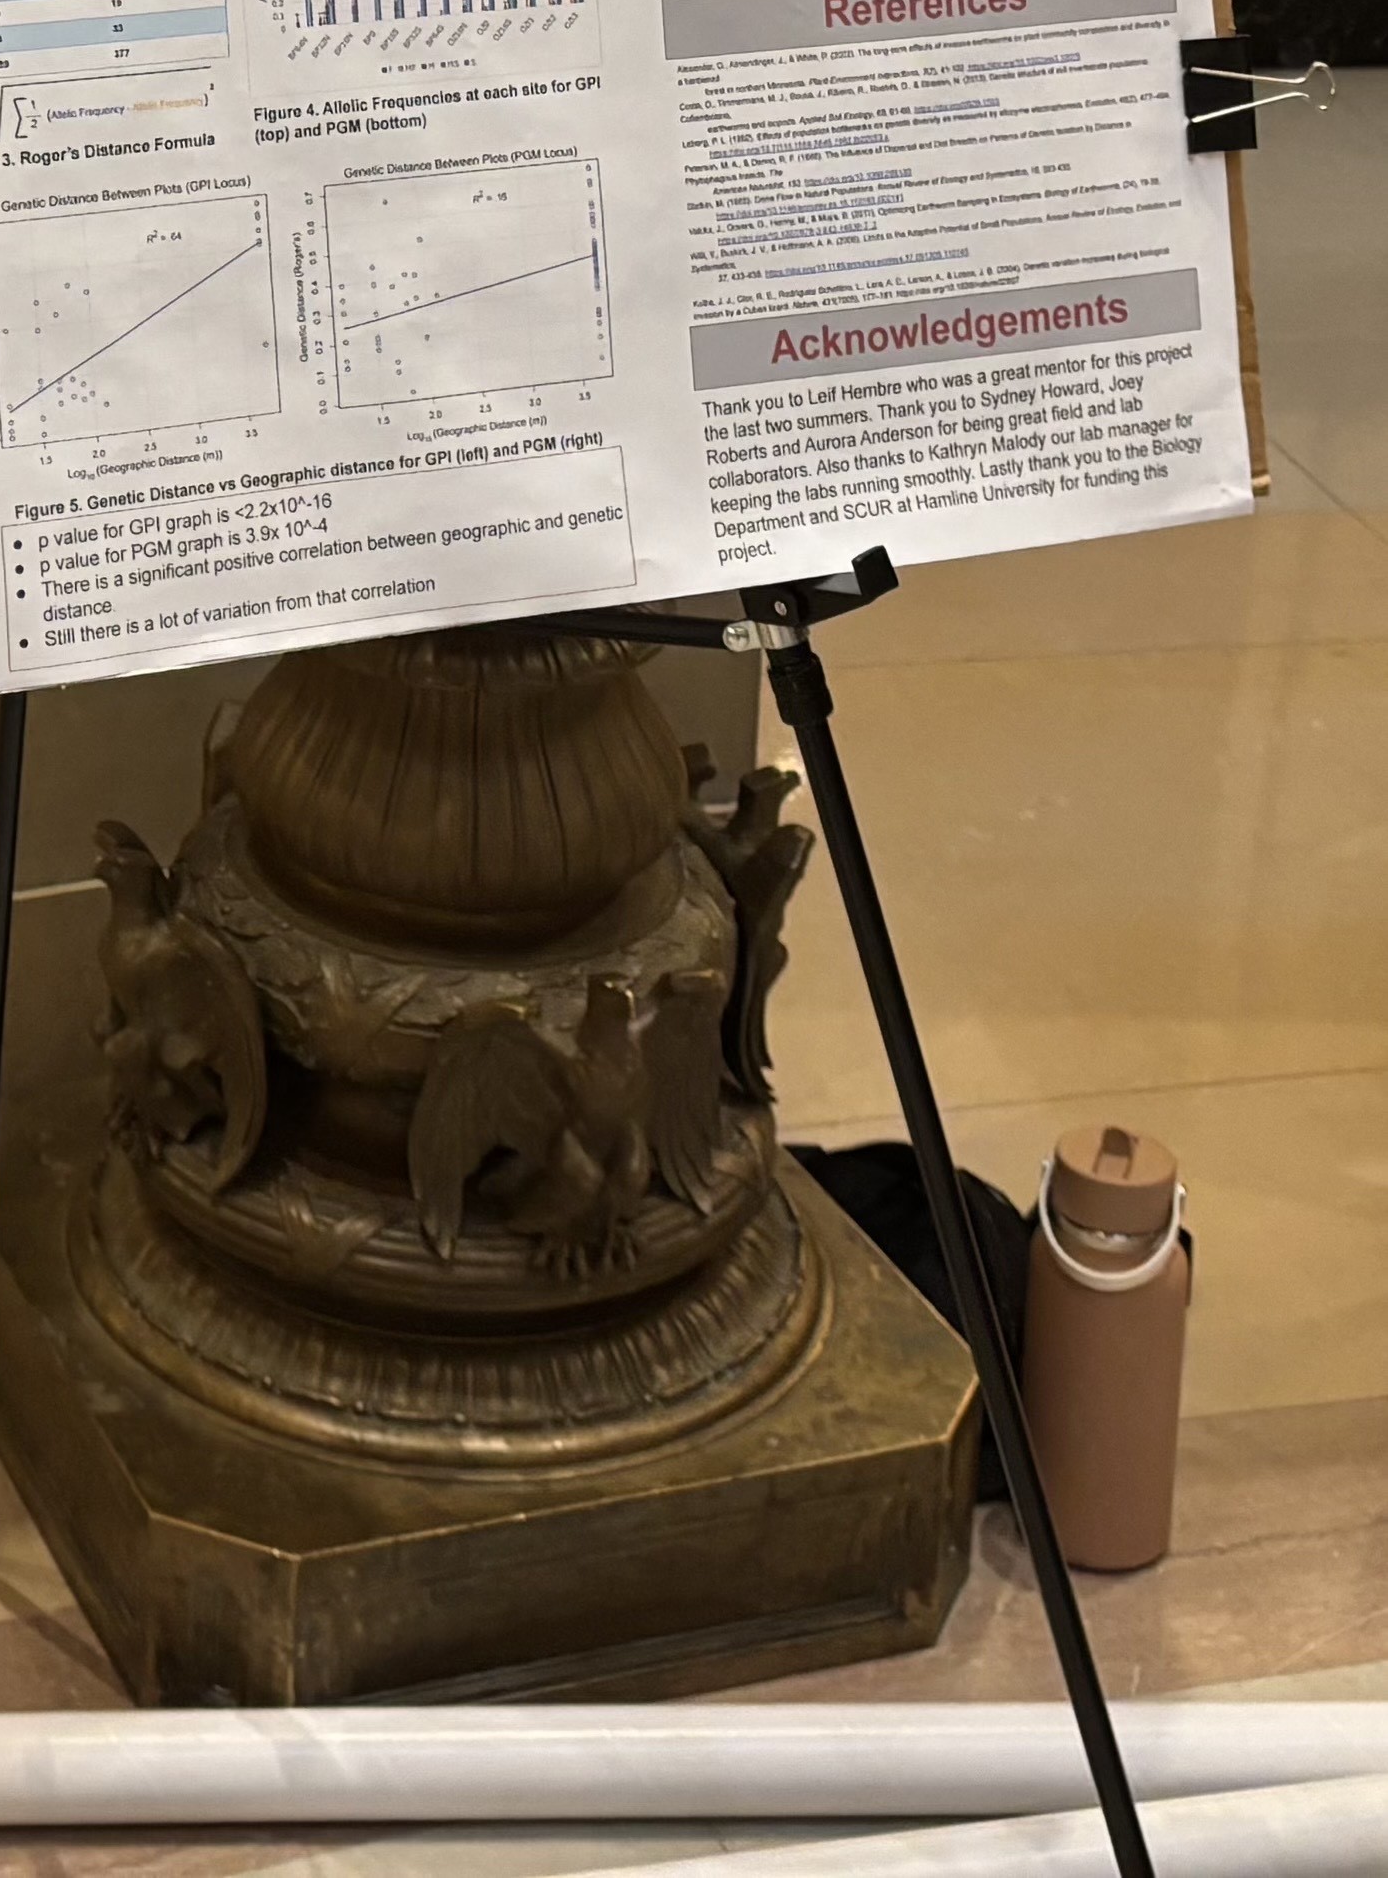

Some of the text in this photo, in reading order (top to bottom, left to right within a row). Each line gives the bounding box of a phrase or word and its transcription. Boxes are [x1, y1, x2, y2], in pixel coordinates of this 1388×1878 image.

[253, 75, 601, 124] Figure 4. Allelic Frequencies at each site for GPI
[1, 152, 16, 167] 3.
[83, 141, 151, 159] Distance
[154, 132, 216, 152] Formula
[770, 293, 1129, 365] Acknowledgements
[713, 464, 1169, 539] Department and SCUR at Hamline University for funding this
